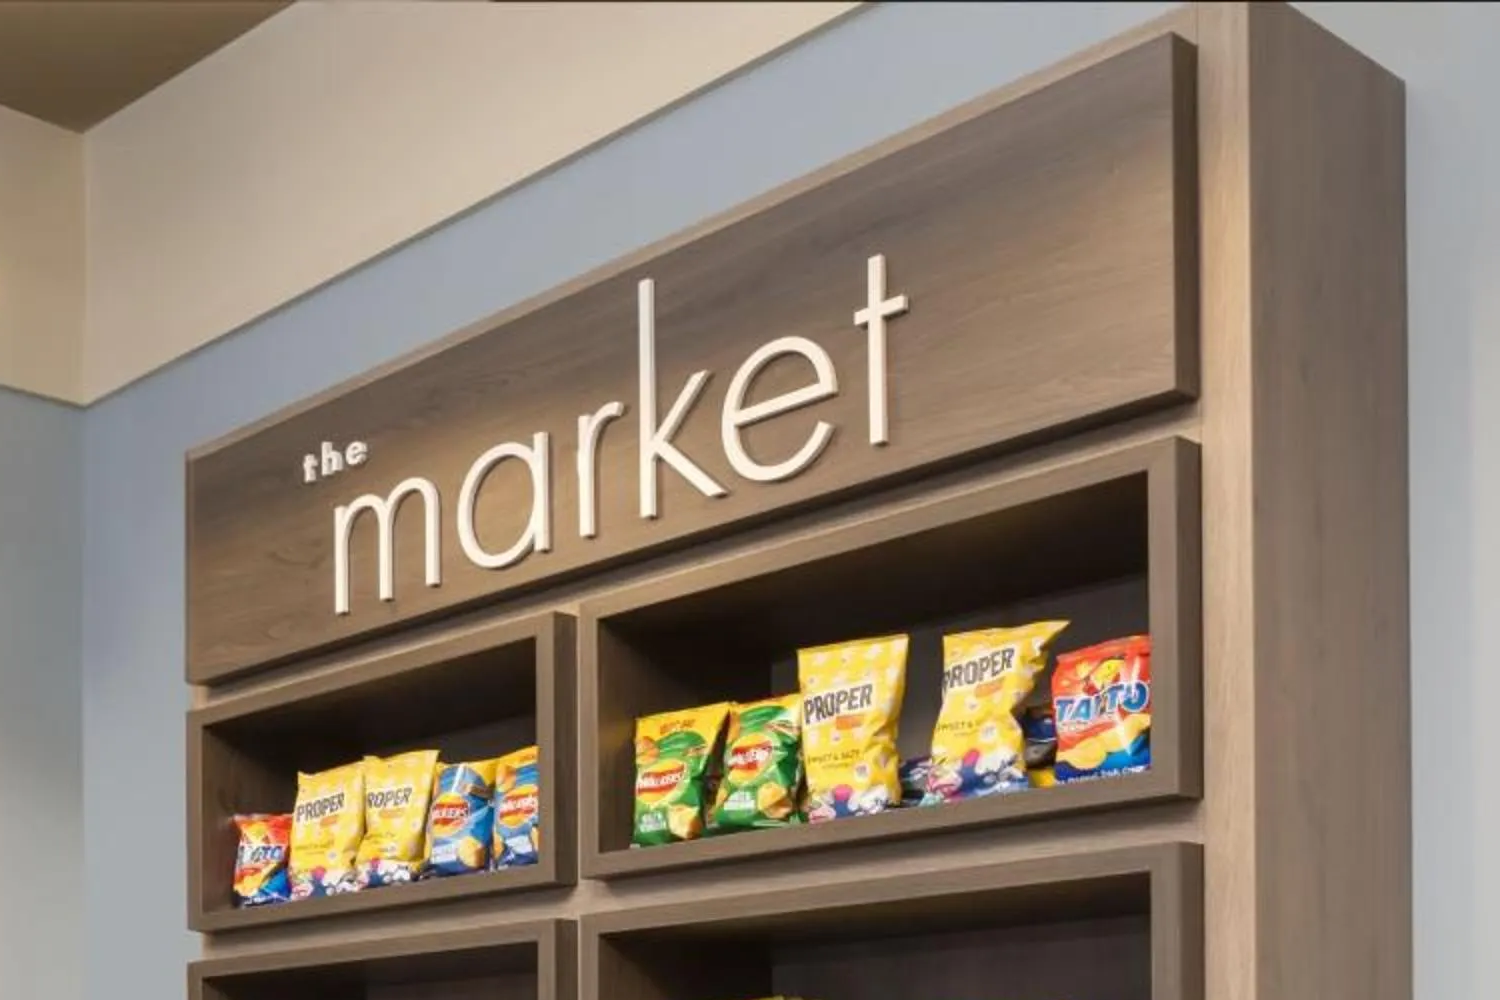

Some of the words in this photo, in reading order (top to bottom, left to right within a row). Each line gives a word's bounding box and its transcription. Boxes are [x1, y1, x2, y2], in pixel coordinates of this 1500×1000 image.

[333, 252, 909, 616] market
[303, 437, 369, 483] the
[942, 649, 1015, 694] PROPER
[804, 683, 874, 725] PROPER
[296, 791, 345, 823] PROPER
[367, 786, 412, 809] ROPER
